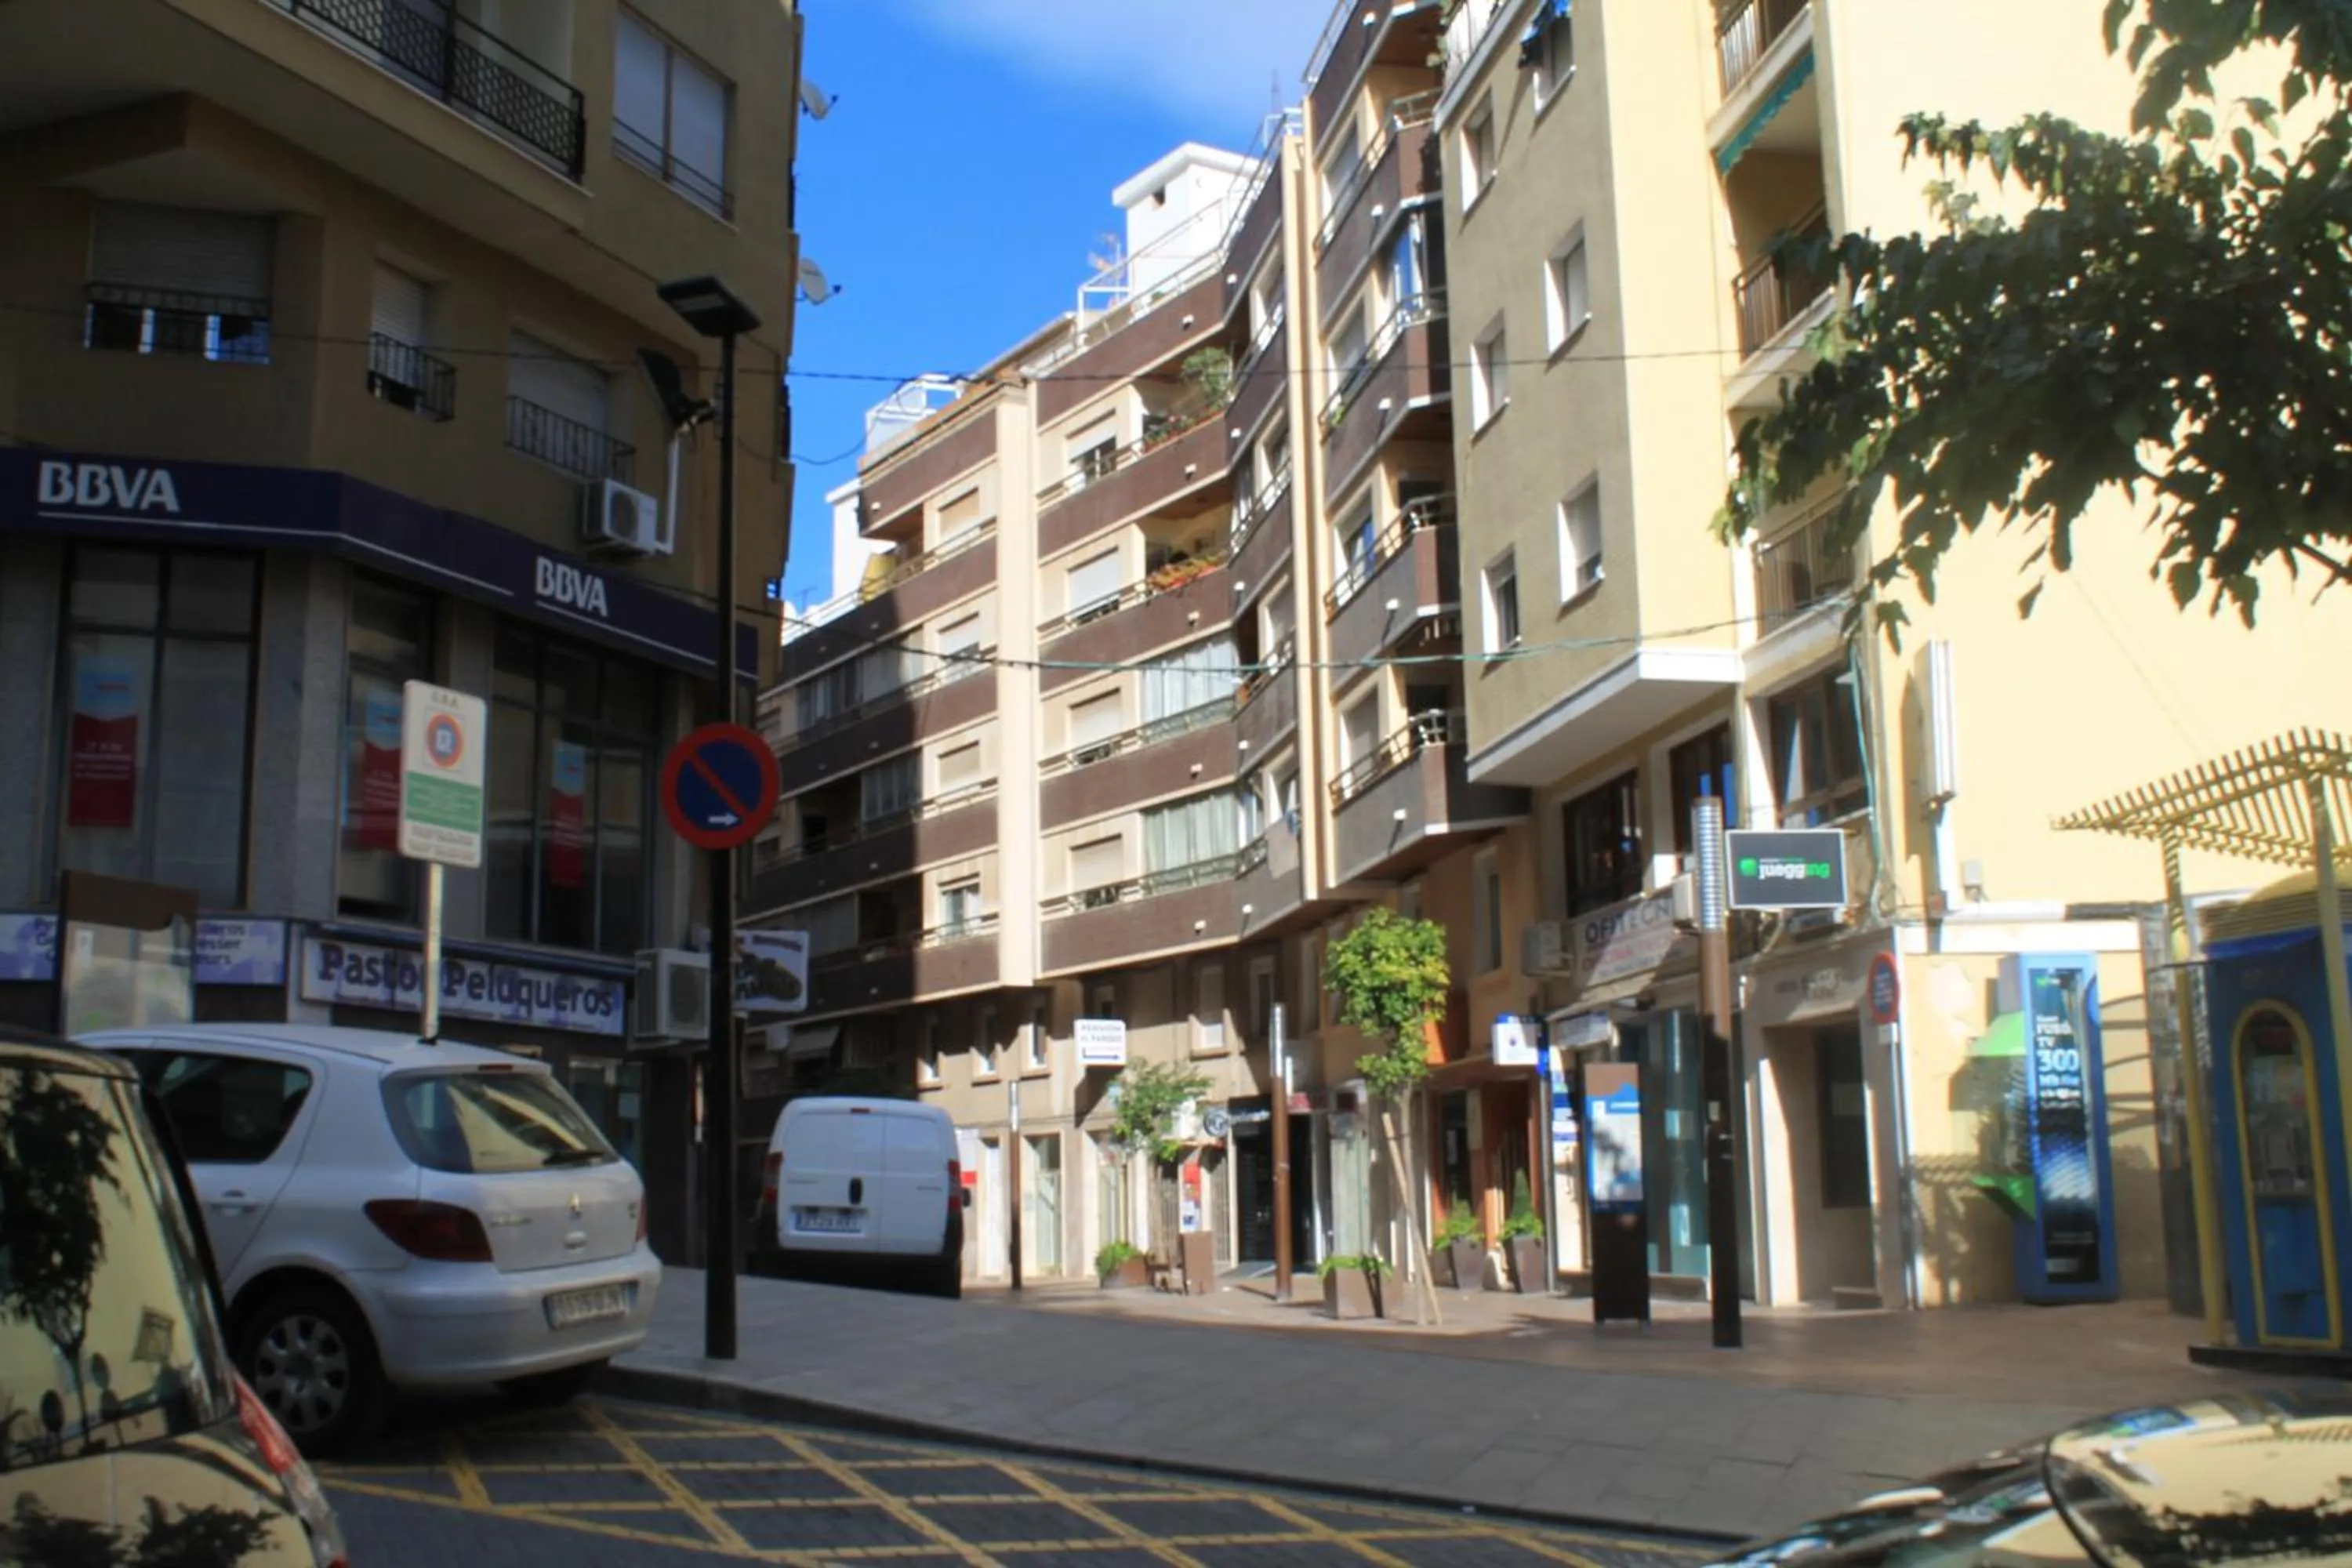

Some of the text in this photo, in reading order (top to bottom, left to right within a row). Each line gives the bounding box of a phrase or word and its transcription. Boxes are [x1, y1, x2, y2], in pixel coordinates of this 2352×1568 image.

[38, 460, 180, 513] BBVA
[536, 555, 608, 618] BBVA
[318, 943, 615, 1018] Pasto Peluqueros
[2036, 1048, 2080, 1073] 300
